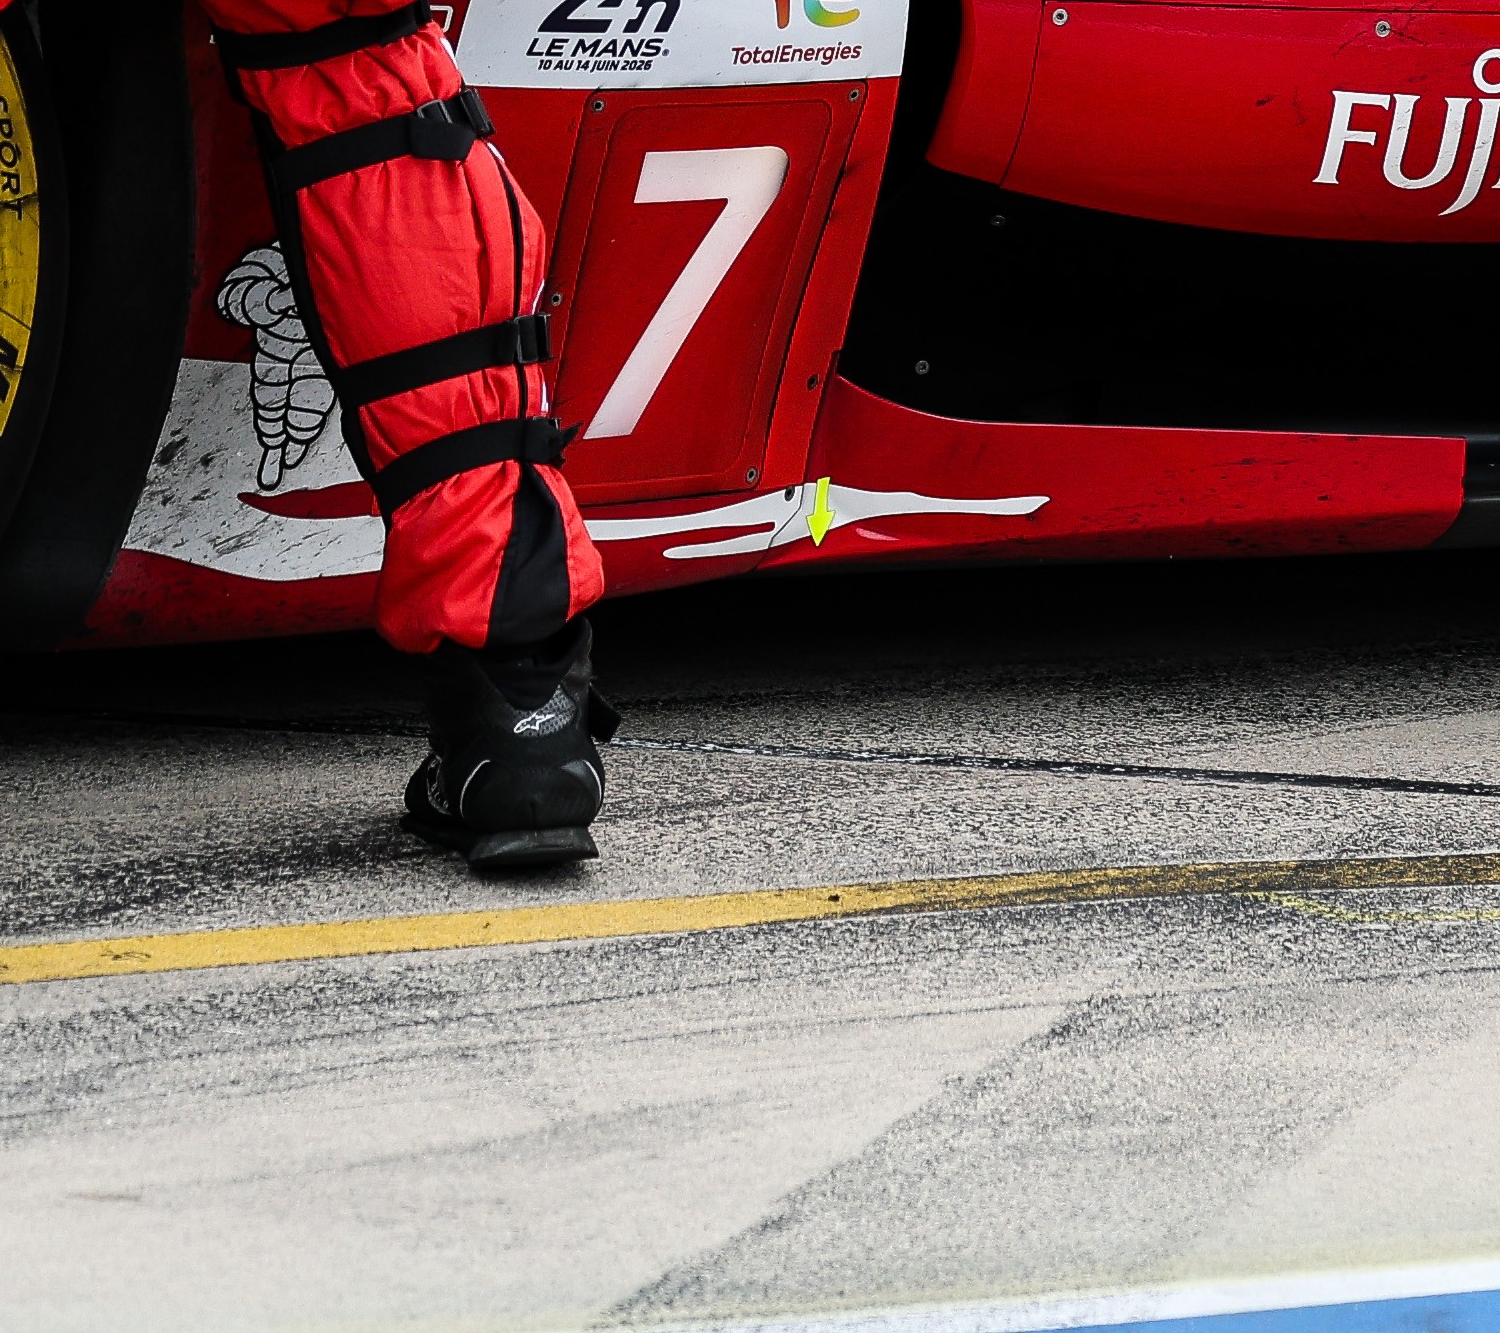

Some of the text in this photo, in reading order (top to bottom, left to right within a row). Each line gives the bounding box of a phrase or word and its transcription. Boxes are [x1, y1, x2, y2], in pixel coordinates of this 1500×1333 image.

[526, 37, 566, 58] LE
[731, 42, 862, 66] TotalEnergies
[537, 59, 653, 74] 10 AU 14 JUIN 2026
[583, 146, 790, 440] 7
